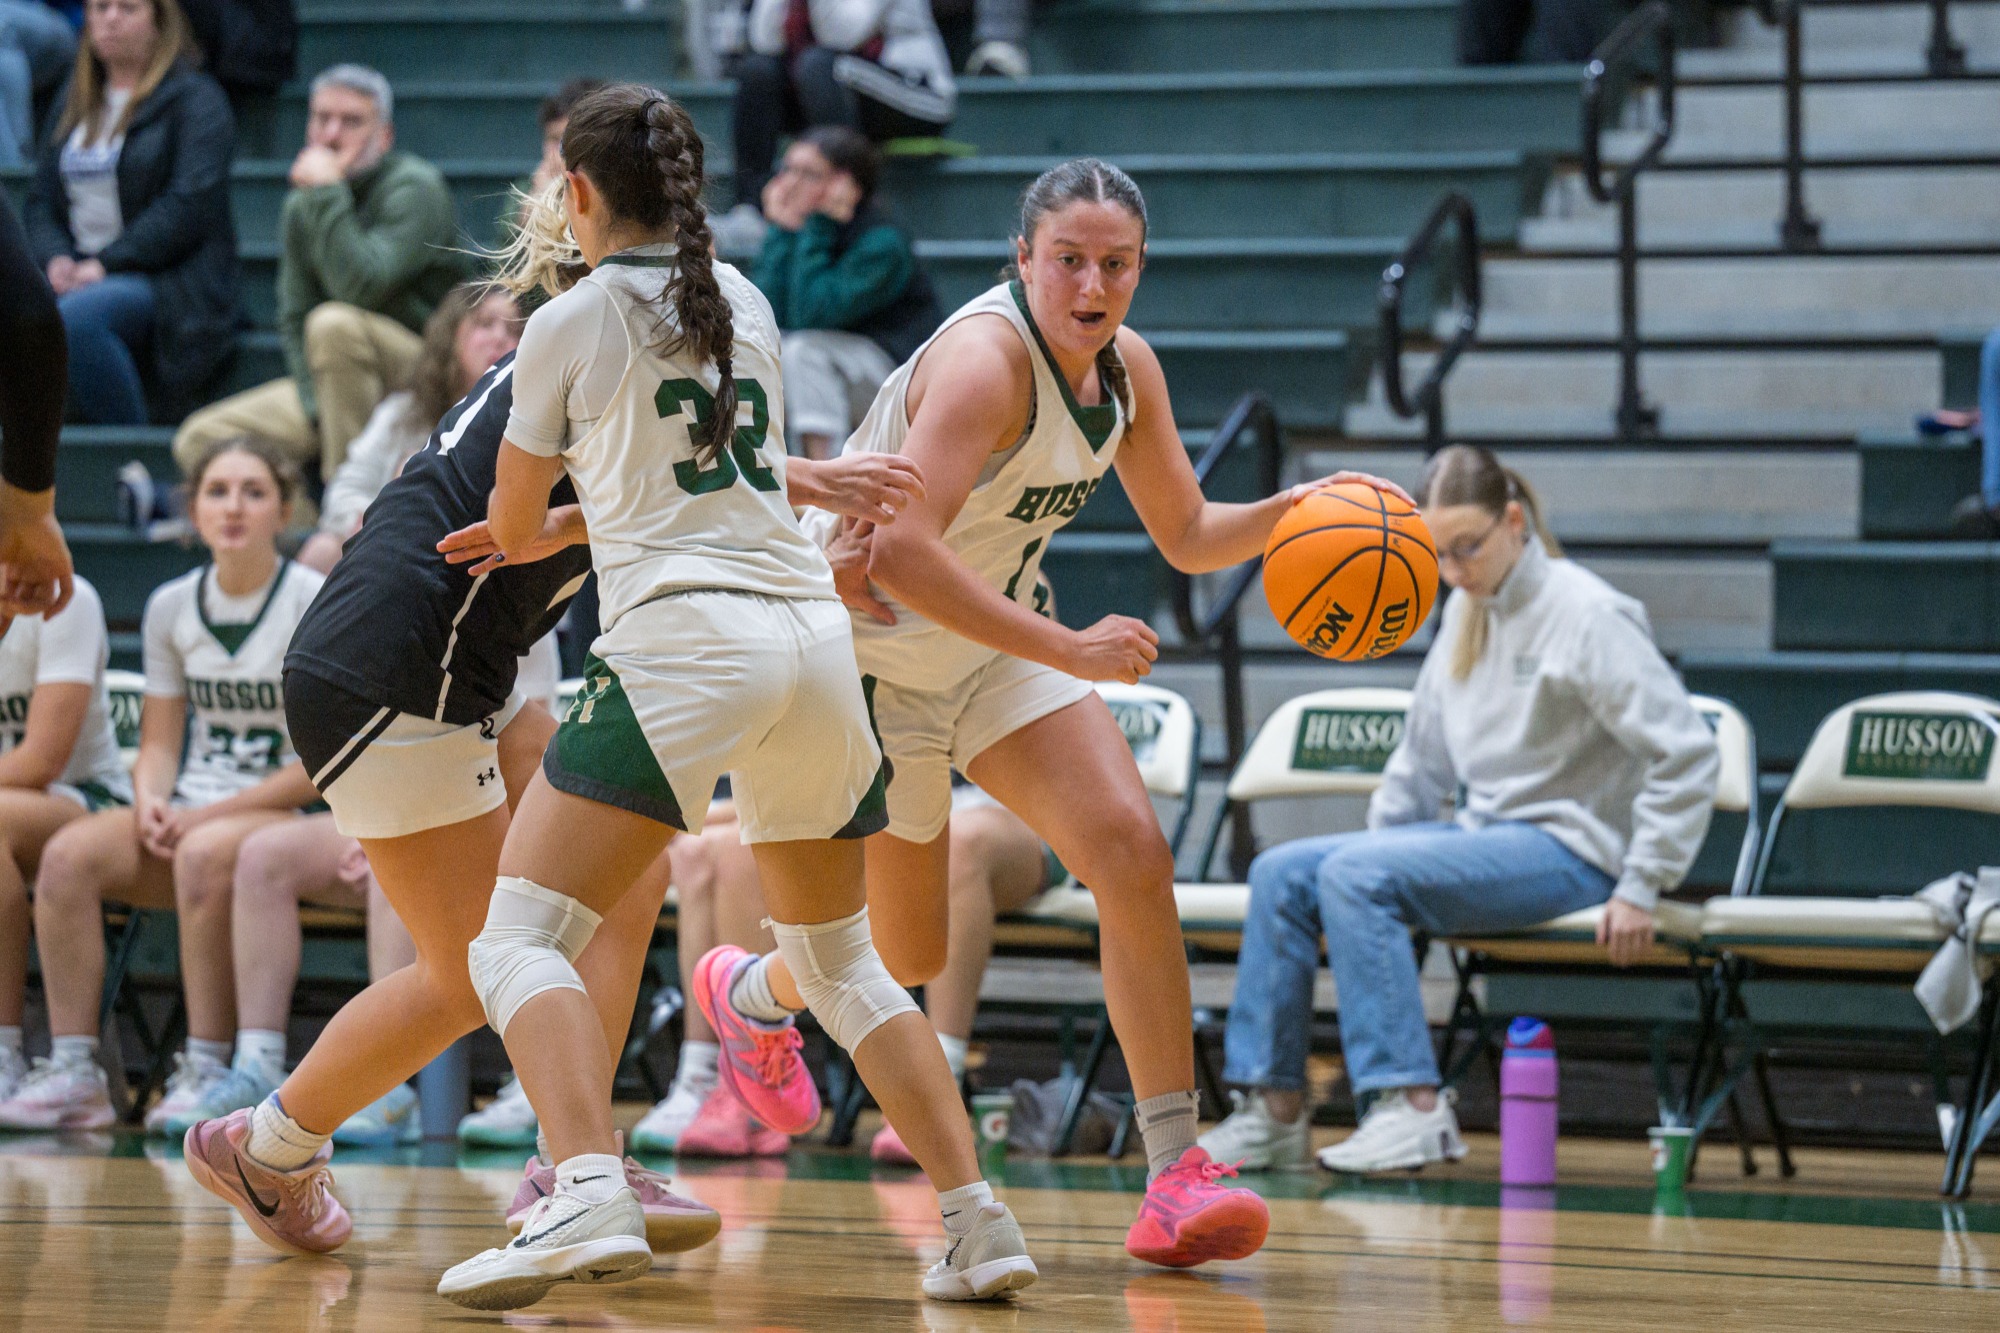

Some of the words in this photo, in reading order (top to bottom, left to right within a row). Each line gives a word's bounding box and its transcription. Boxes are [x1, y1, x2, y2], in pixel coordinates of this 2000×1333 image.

[653, 377, 782, 496] 32
[185, 678, 284, 710] USSO
[1303, 712, 1405, 752] HUSSO
[1858, 716, 1987, 758] HUSSON
